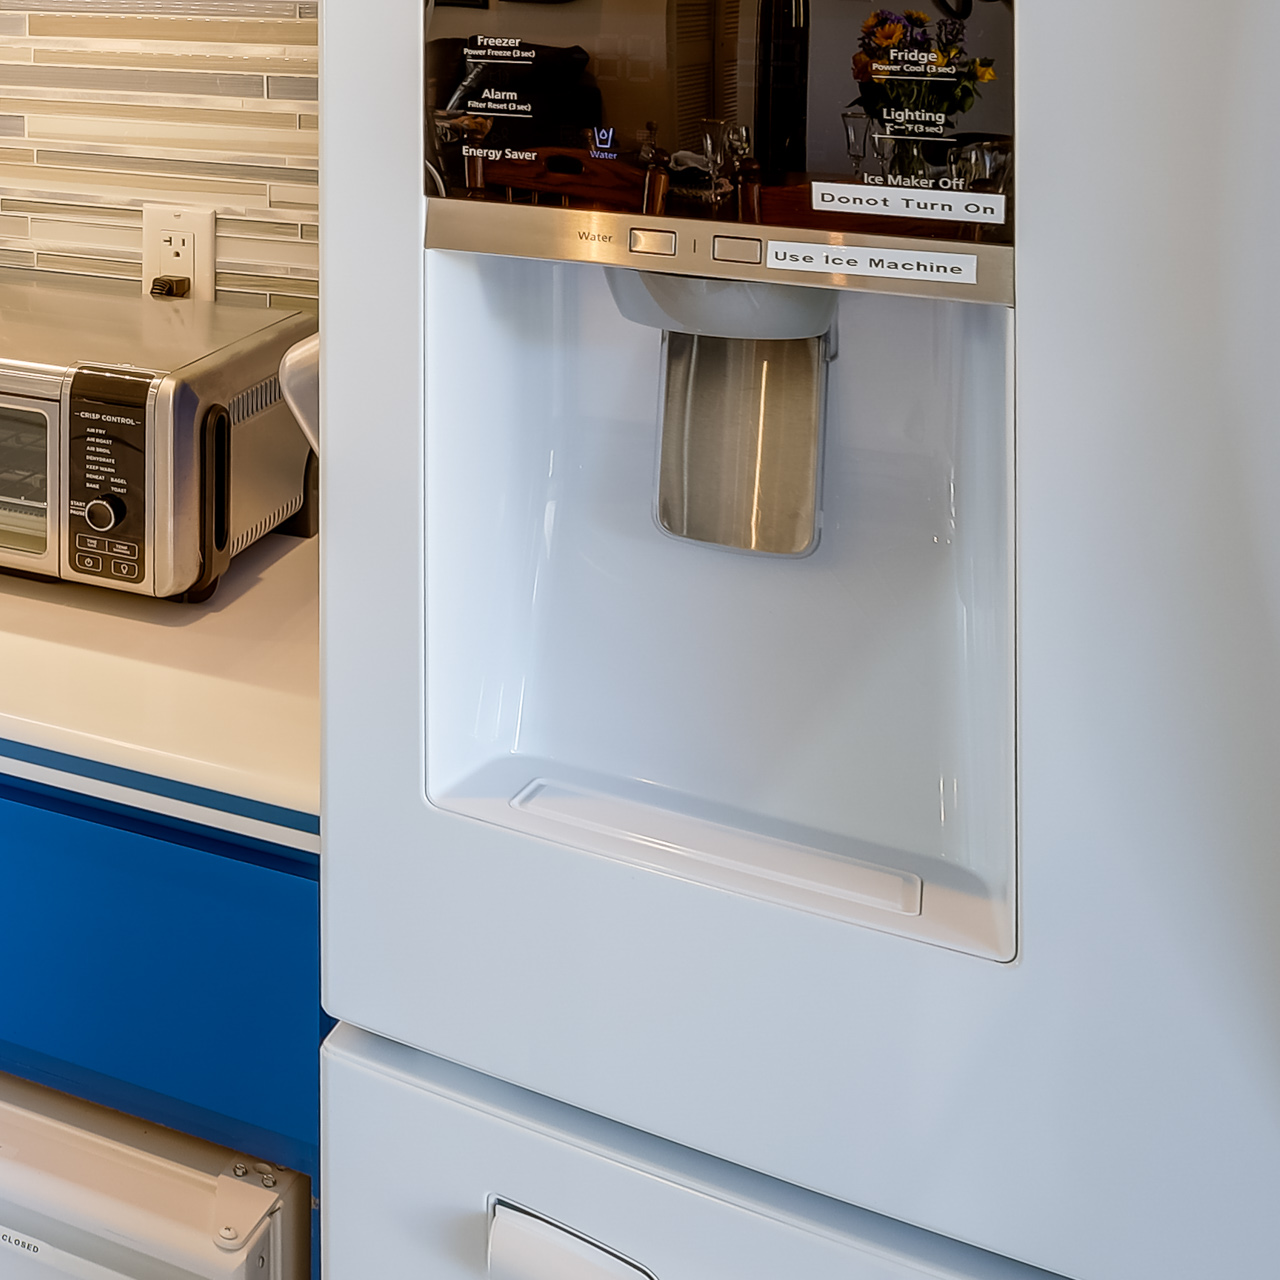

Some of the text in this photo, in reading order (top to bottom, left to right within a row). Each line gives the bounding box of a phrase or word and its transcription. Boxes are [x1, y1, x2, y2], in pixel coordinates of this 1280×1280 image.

[477, 35, 521, 47] Freezer
[463, 48, 535, 58] Power Freeze (3 sec)
[890, 49, 938, 63] Fridge
[872, 63, 956, 74] Power Cool (3 sec)
[481, 89, 518, 100] Alarm
[467, 101, 532, 111] Filter Reset (3 sec)
[883, 108, 946, 124] Lighting
[462, 146, 538, 160] Energy Saver
[589, 150, 618, 160] Water
[863, 172, 965, 190] Ice Maker Off
[820, 192, 995, 215] Donot Turn On
[577, 231, 613, 242] Water
[774, 250, 963, 275] Use Ice Machine
[80, 411, 136, 425] CRISP CONTROL
[86, 455, 115, 464] DEHYDRATE
[1, 1234, 39, 1253] CLOSED
